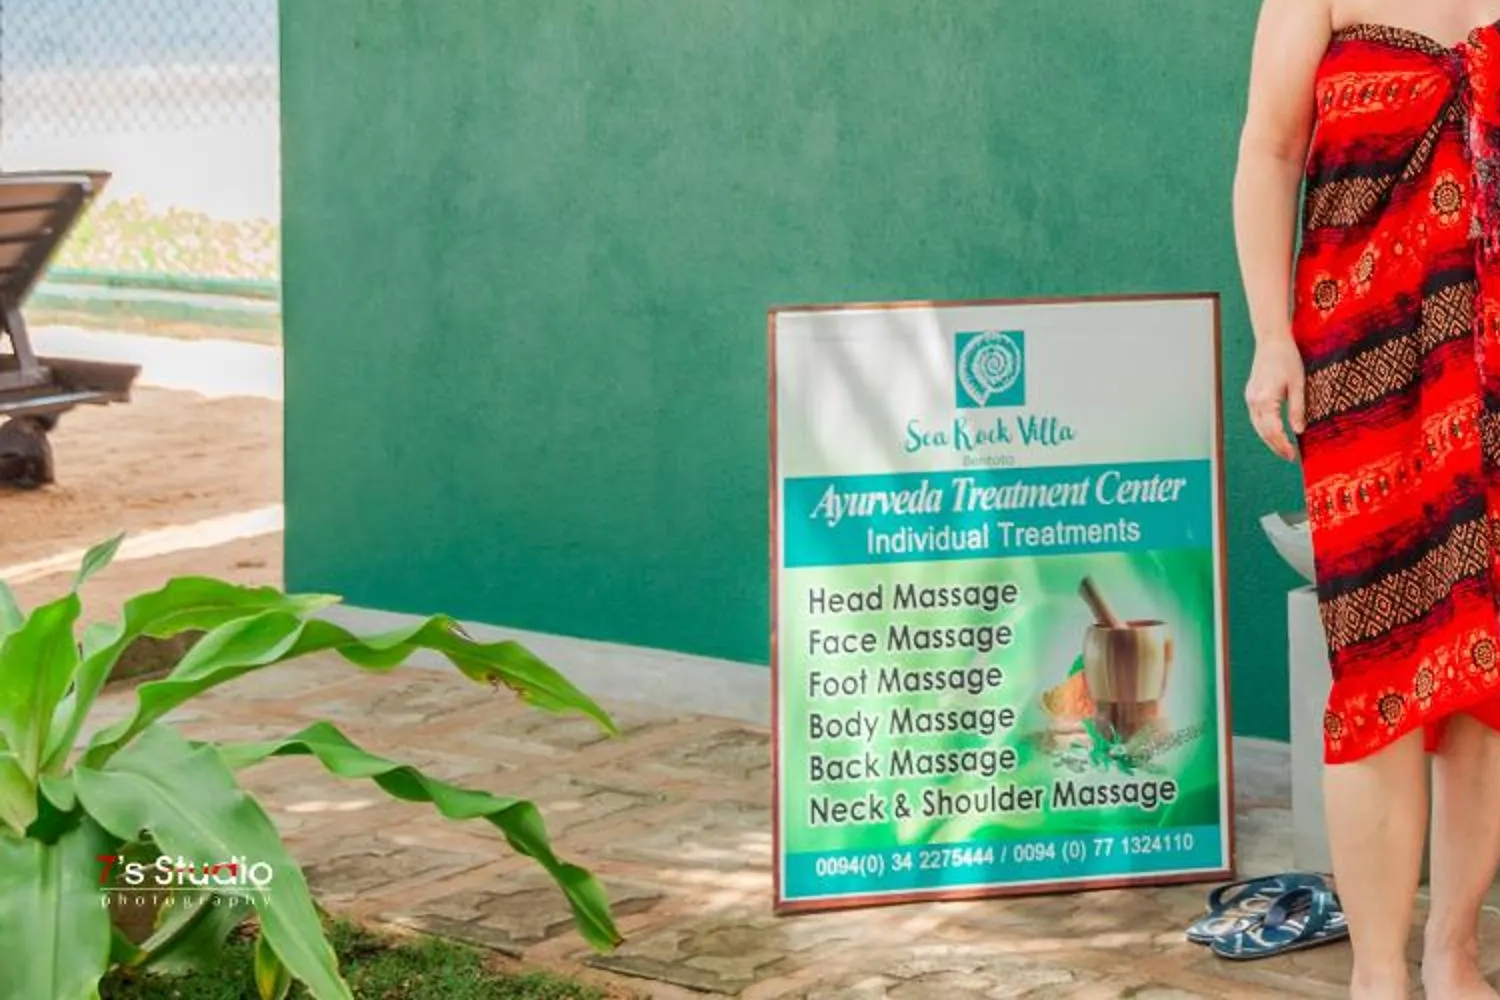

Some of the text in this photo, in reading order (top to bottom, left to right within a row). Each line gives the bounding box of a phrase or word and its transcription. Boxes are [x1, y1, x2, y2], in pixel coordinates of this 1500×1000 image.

[904, 415, 1075, 453] Sea Rock Villa
[809, 470, 1187, 528] Ayurveda Treatment Center
[867, 518, 1141, 554] Individual Treatments
[809, 582, 1018, 614] Head Massage
[809, 623, 1012, 655] Face Massage
[809, 665, 1003, 697] Foot Massage
[809, 706, 1015, 741] Body Massage
[809, 747, 1016, 781] Back Massage
[809, 778, 1177, 824] Neck & Shoulder Massage
[816, 833, 1194, 877] 0094(0) 34 2275444 / 0094 (0) 77 1324110
